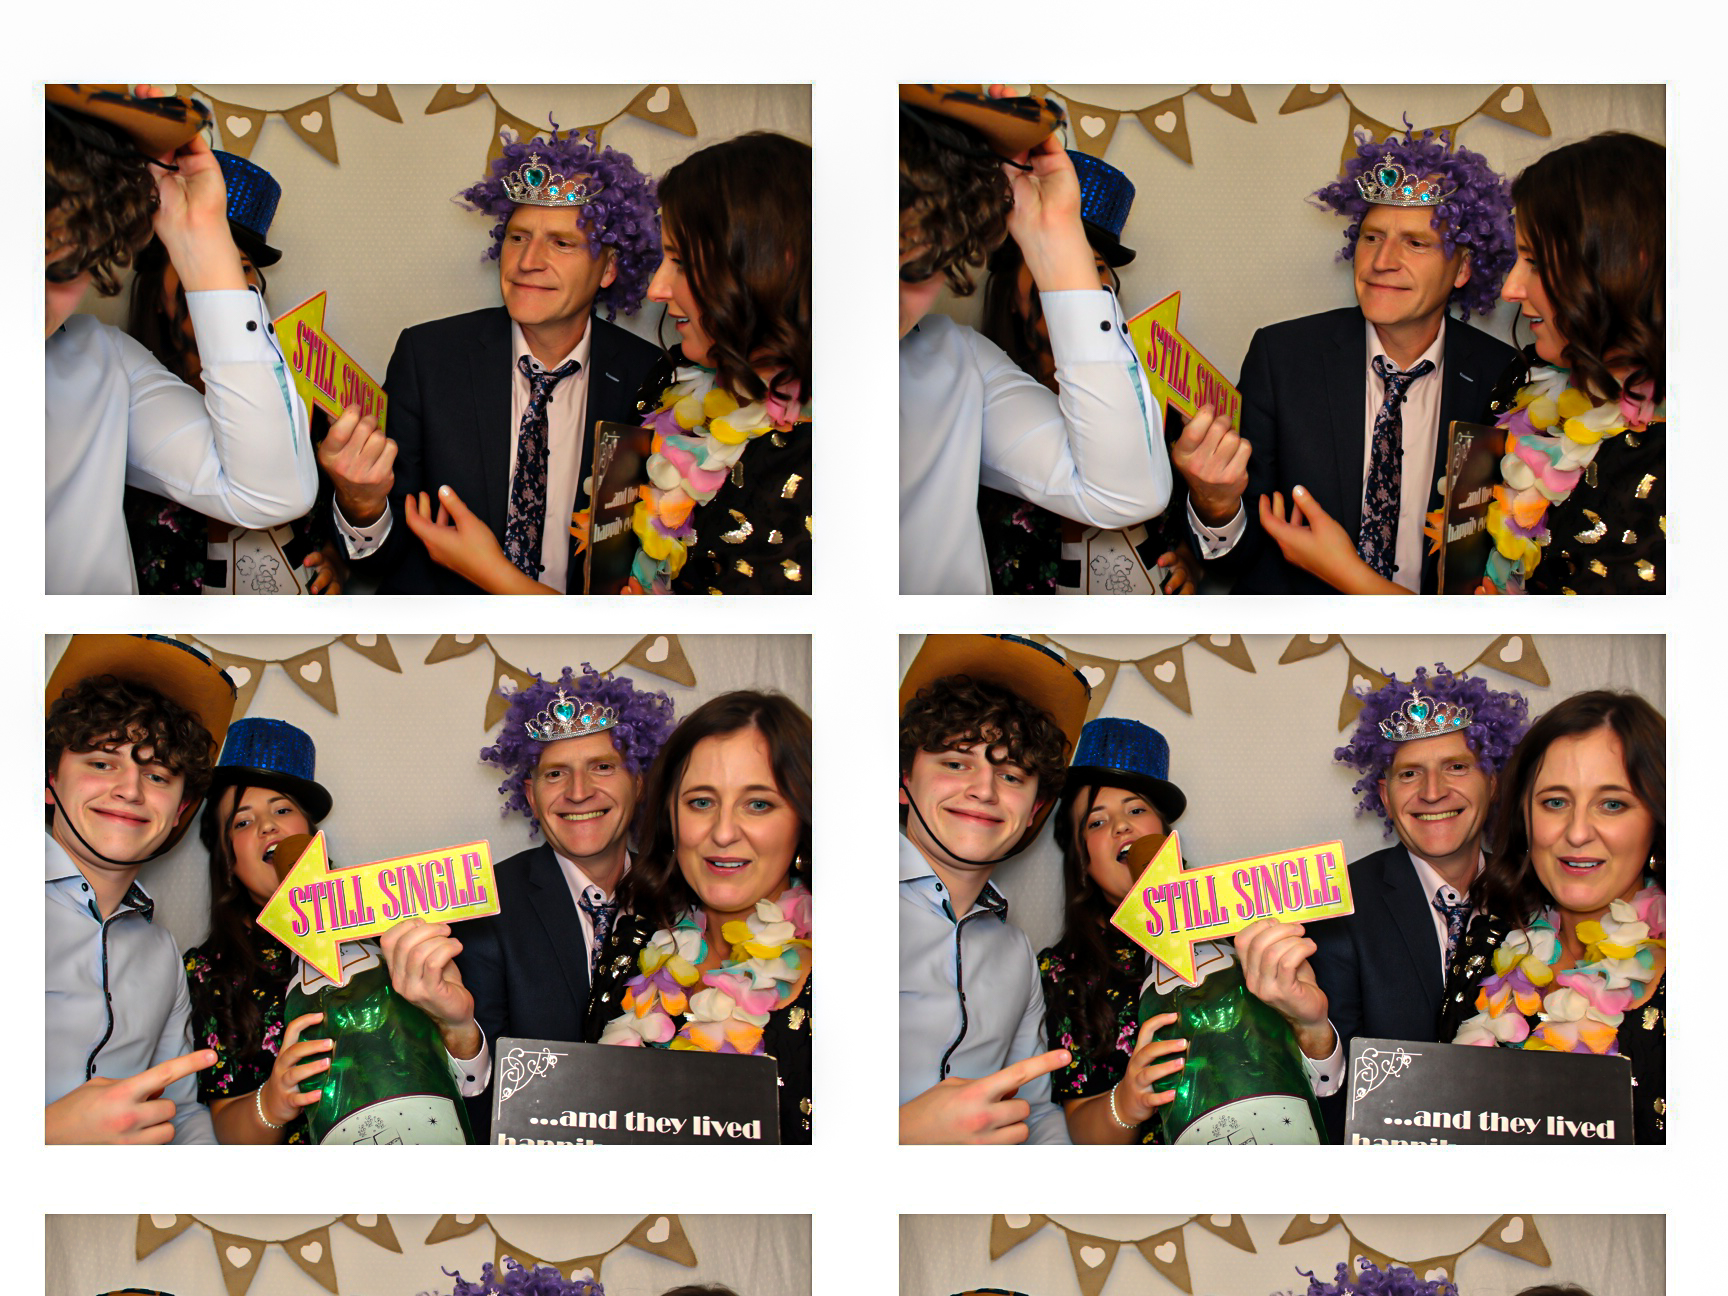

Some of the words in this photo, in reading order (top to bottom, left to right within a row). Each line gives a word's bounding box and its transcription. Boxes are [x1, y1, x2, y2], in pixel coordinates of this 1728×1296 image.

[293, 319, 337, 402] STILL
[1147, 319, 1191, 402] STILL
[289, 875, 375, 937] STILL
[378, 852, 488, 920] SINGLE
[1143, 875, 1229, 937] STILL
[1232, 852, 1342, 920] SINGLE
[624, 1111, 687, 1135] they
[693, 1116, 761, 1139] lived
[1478, 1111, 1541, 1135] they
[1547, 1116, 1615, 1139] lived
